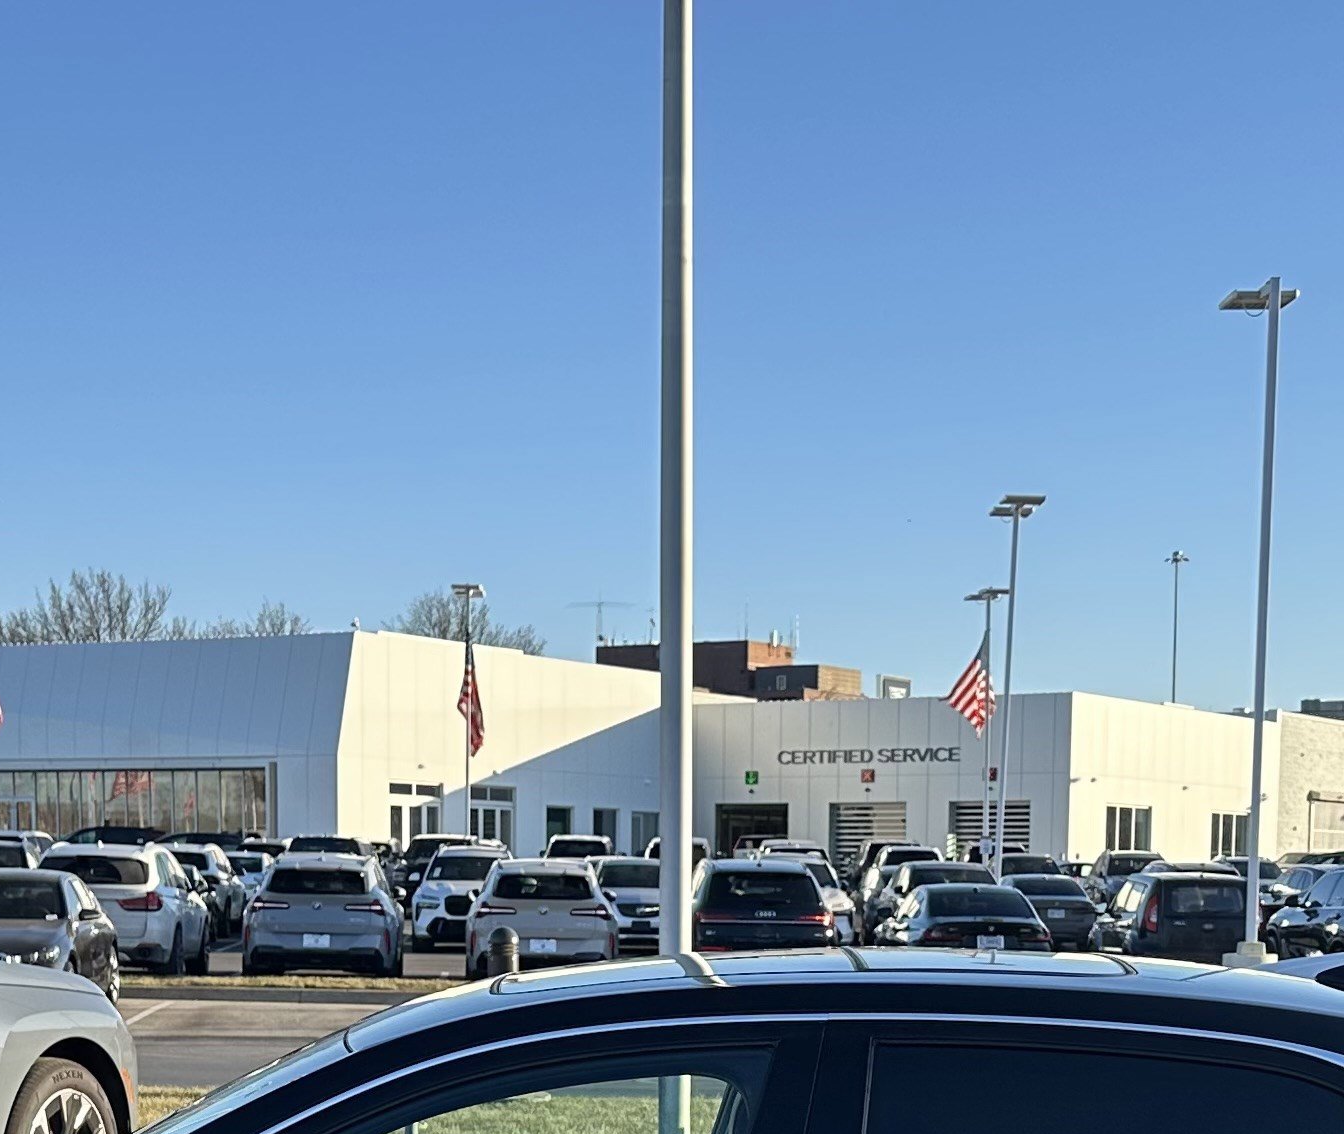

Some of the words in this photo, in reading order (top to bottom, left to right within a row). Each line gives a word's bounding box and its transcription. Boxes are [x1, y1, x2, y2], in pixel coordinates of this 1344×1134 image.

[777, 749, 874, 765] CERTIFIED
[876, 747, 961, 763] SERVICE
[52, 1069, 84, 1084] NEXEN
